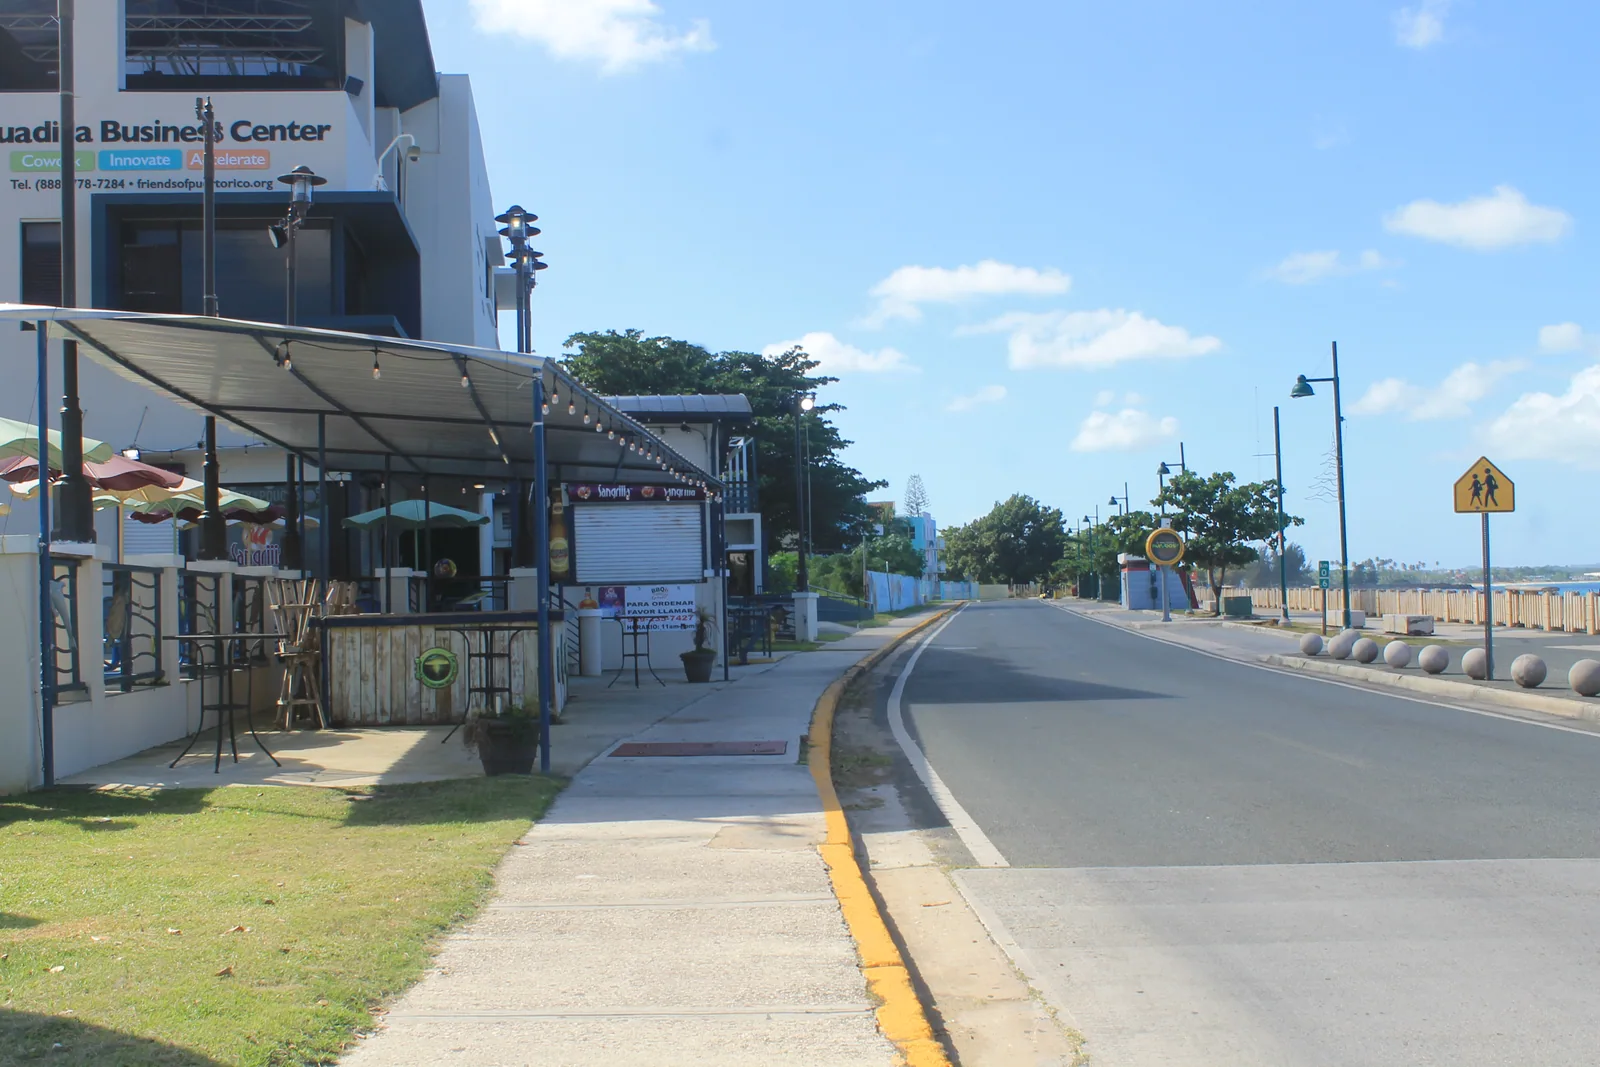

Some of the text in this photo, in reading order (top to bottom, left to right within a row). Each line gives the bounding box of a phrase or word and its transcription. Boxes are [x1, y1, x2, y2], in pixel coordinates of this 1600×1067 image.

[0, 120, 93, 143] uadia
[230, 120, 331, 143] Center
[22, 153, 266, 168] Cowok Innovate Aelerate
[10, 179, 31, 190] Tel.
[74, 178, 125, 189] 78-7284
[137, 178, 273, 191] friendsofputorico.org
[1321, 569, 1327, 577] 0
